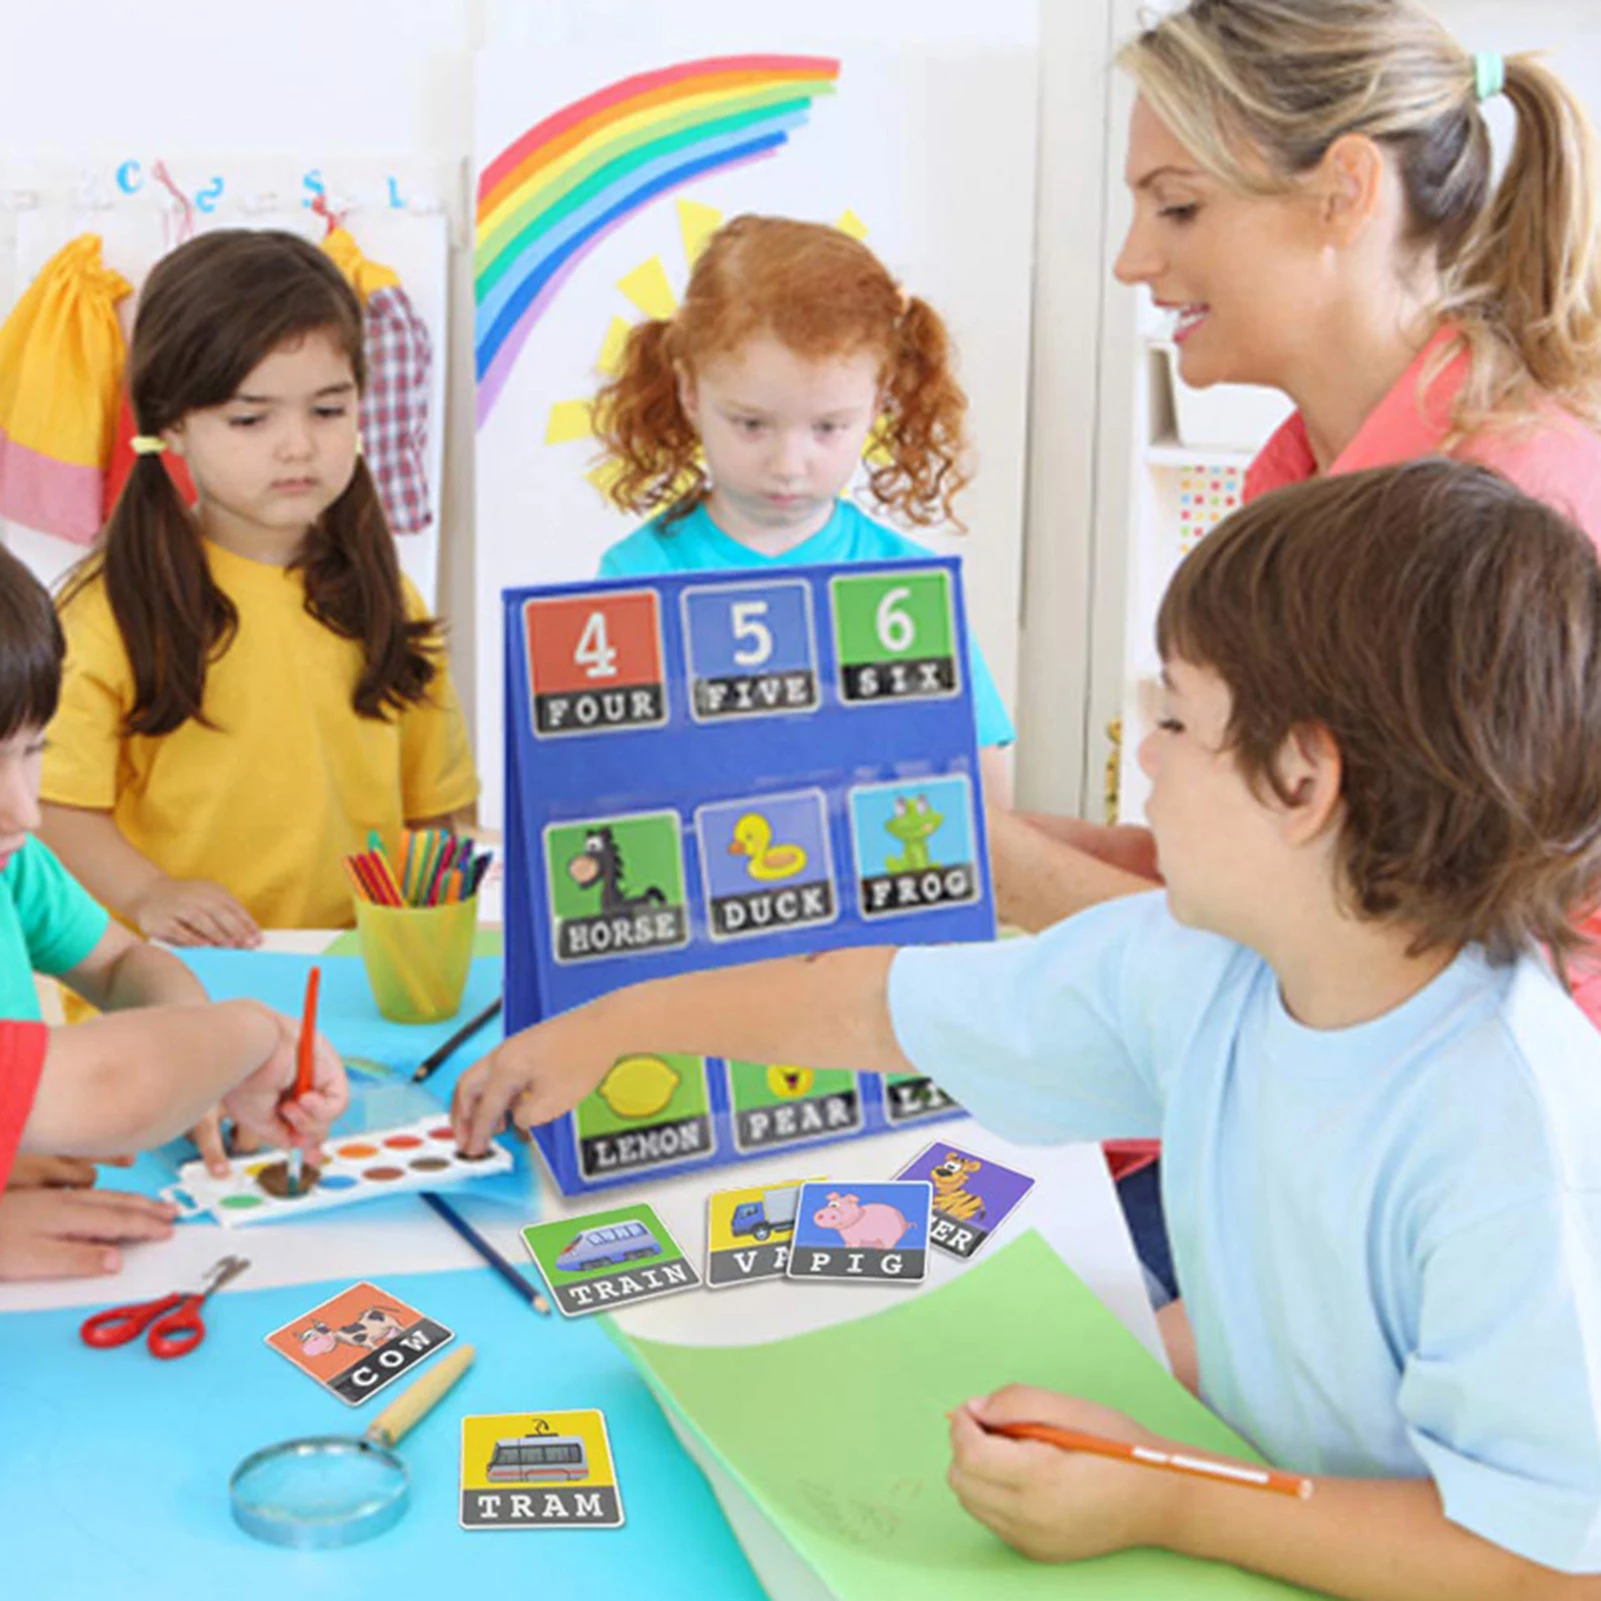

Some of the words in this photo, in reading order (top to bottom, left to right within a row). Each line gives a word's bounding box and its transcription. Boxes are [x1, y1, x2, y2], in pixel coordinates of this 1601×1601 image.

[730, 601, 773, 665] 5
[877, 587, 914, 651] 6
[574, 611, 618, 679] 4
[706, 678, 808, 710] FIVE
[858, 663, 943, 693] SIX
[547, 690, 657, 728] FOUR
[872, 868, 969, 907] FROG
[723, 888, 825, 929] DUCK
[568, 912, 676, 953] HORSE
[750, 1098, 850, 1140] PEAR
[594, 1123, 702, 1168] LEMON
[930, 1214, 974, 1252] ER
[809, 1252, 903, 1273] PIG
[569, 1263, 688, 1307] TRAIN
[352, 1329, 432, 1387] COW
[478, 1493, 604, 1518] TRAM
